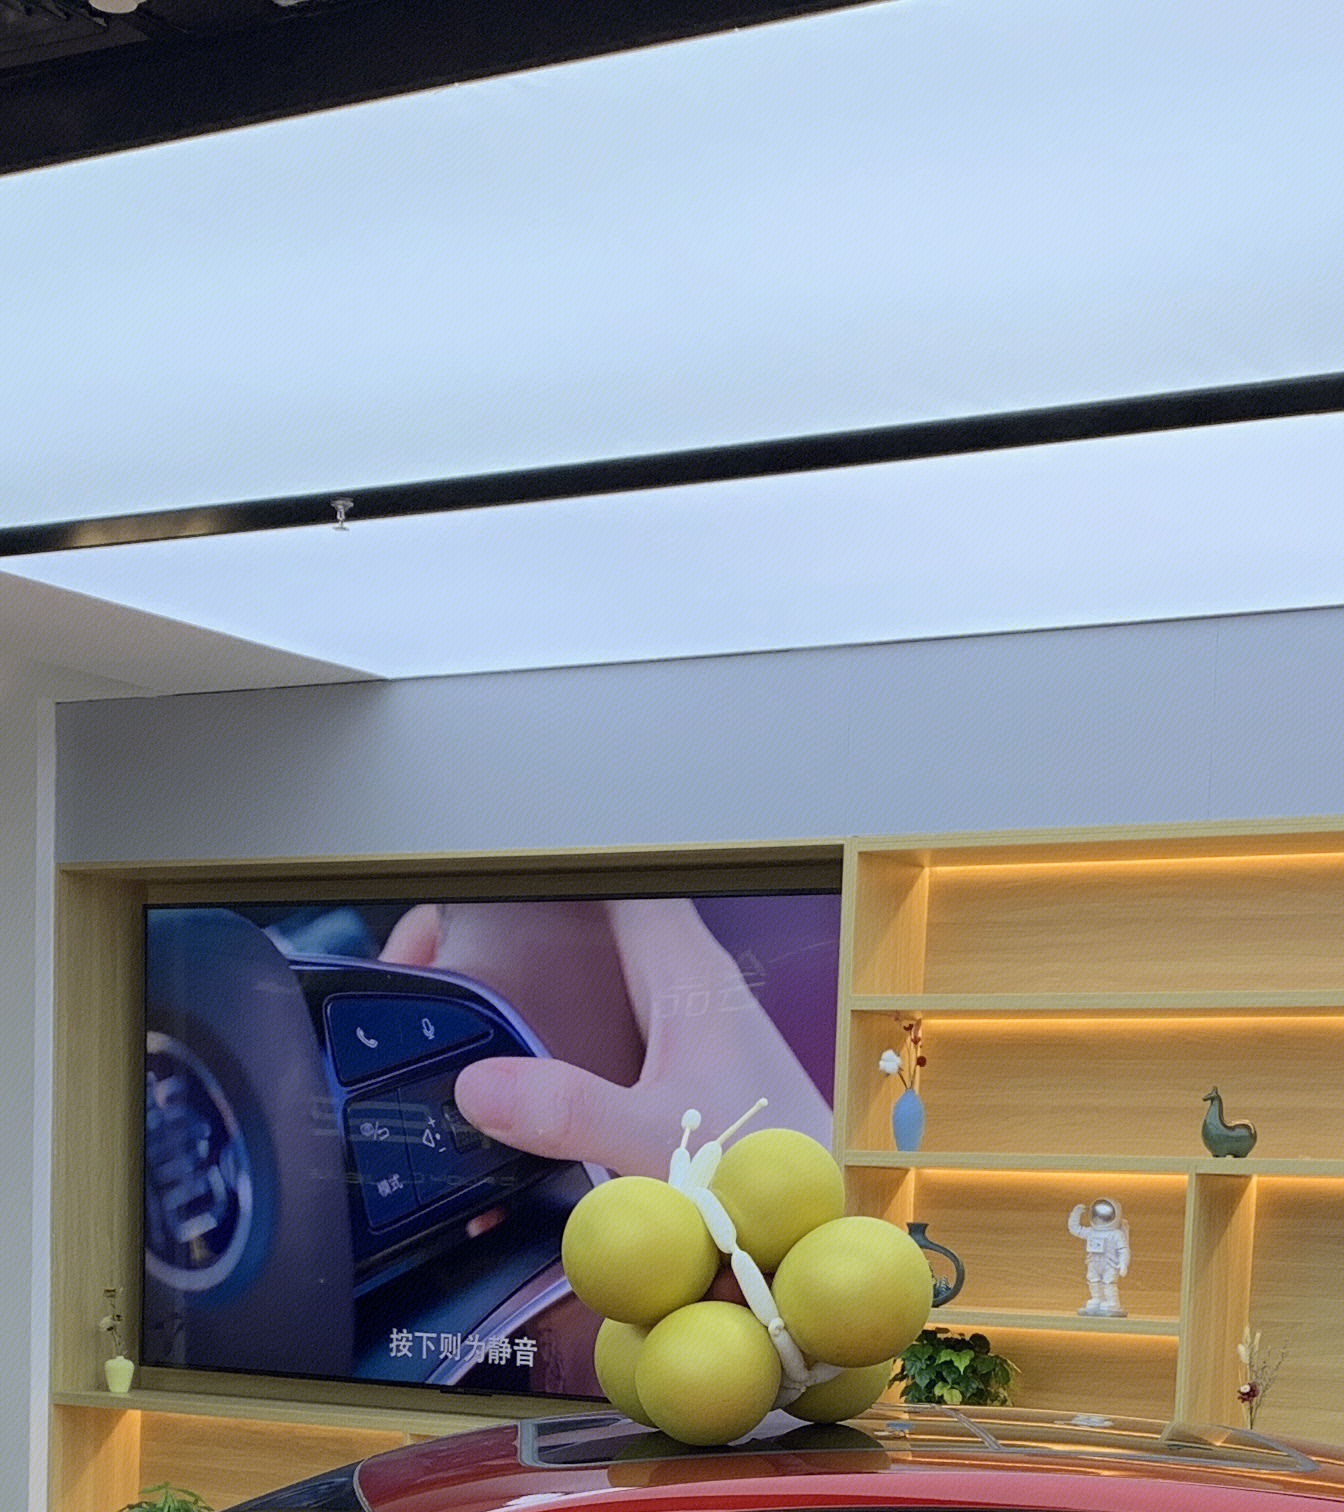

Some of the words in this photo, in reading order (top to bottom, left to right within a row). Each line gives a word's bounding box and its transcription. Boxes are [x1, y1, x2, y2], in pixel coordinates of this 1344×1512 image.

[389, 1327, 538, 1368] 按下则为静音
